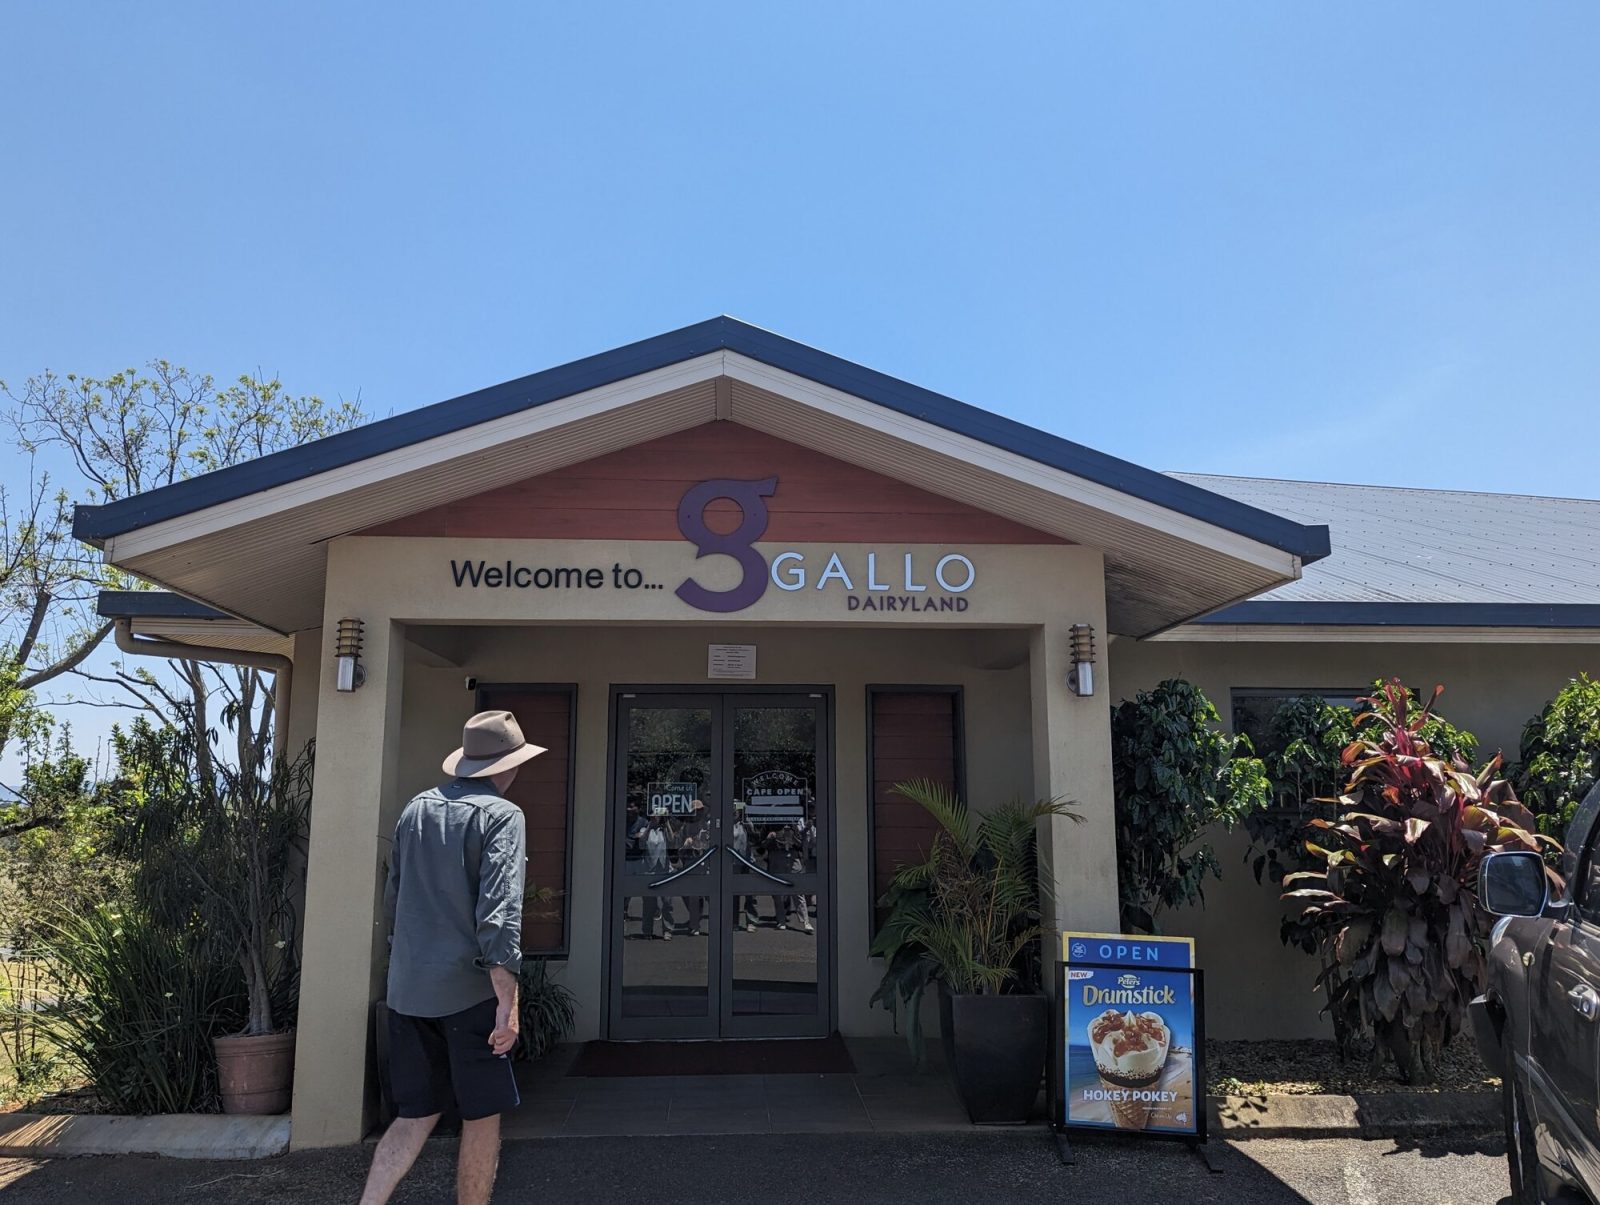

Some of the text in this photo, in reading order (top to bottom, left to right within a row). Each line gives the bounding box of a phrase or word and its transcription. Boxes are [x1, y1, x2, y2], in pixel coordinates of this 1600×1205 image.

[674, 476, 779, 613] g
[450, 560, 664, 590] Welcome to...
[771, 551, 976, 593] GALLO
[847, 595, 969, 613] DAIRYLAND
[752, 772, 799, 786] WELCOME
[651, 794, 693, 813] OPEN
[1099, 944, 1159, 961] OPEN
[1083, 984, 1176, 1006] Drumstick
[1083, 1089, 1178, 1103] HOKEY POKEY
